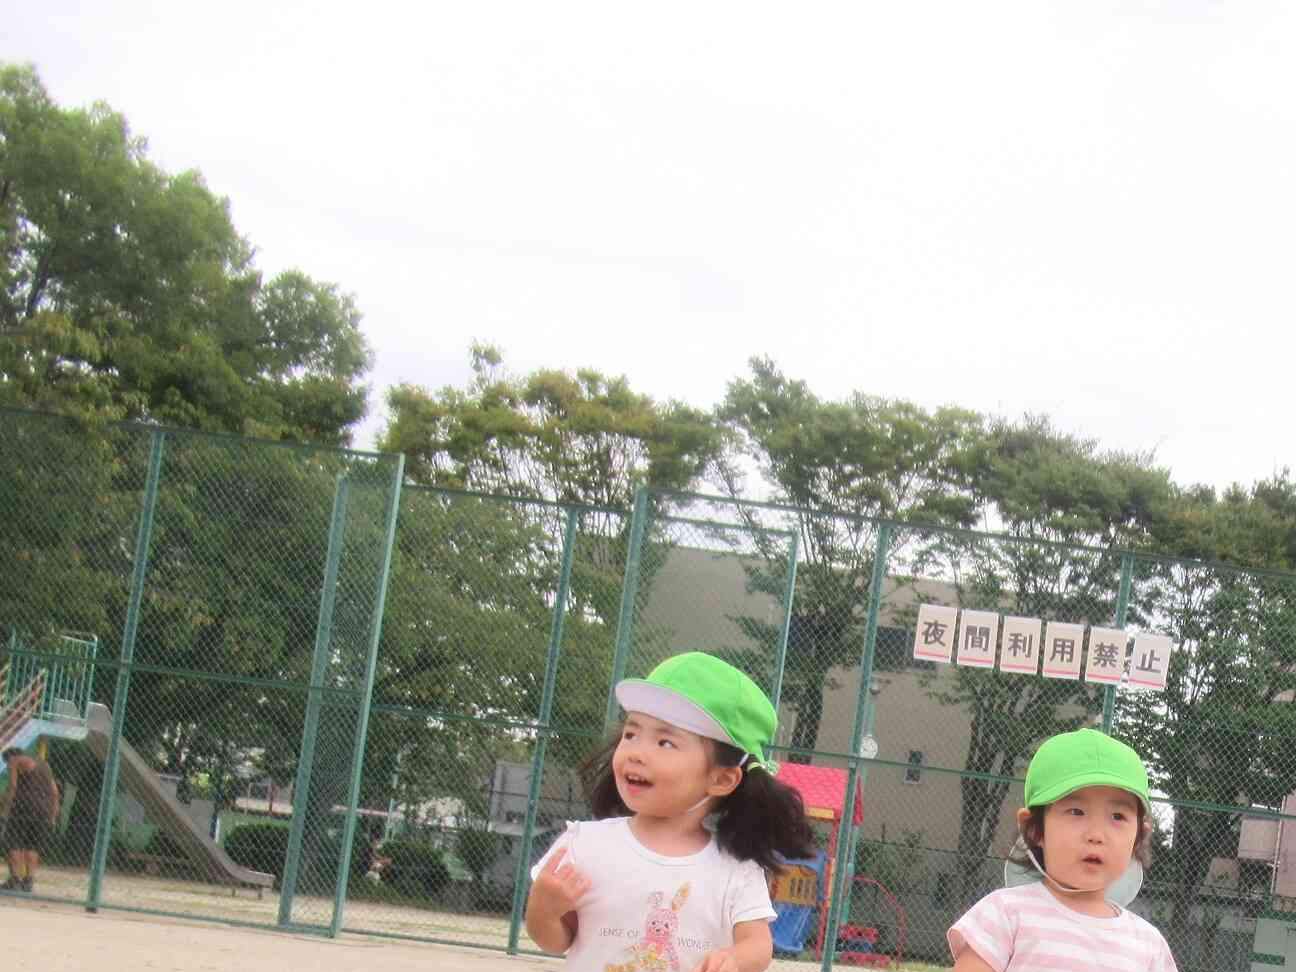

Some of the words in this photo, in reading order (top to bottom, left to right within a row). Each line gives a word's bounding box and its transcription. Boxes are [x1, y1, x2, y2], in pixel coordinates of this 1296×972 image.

[921, 619, 1162, 673] 夜間利用禁止
